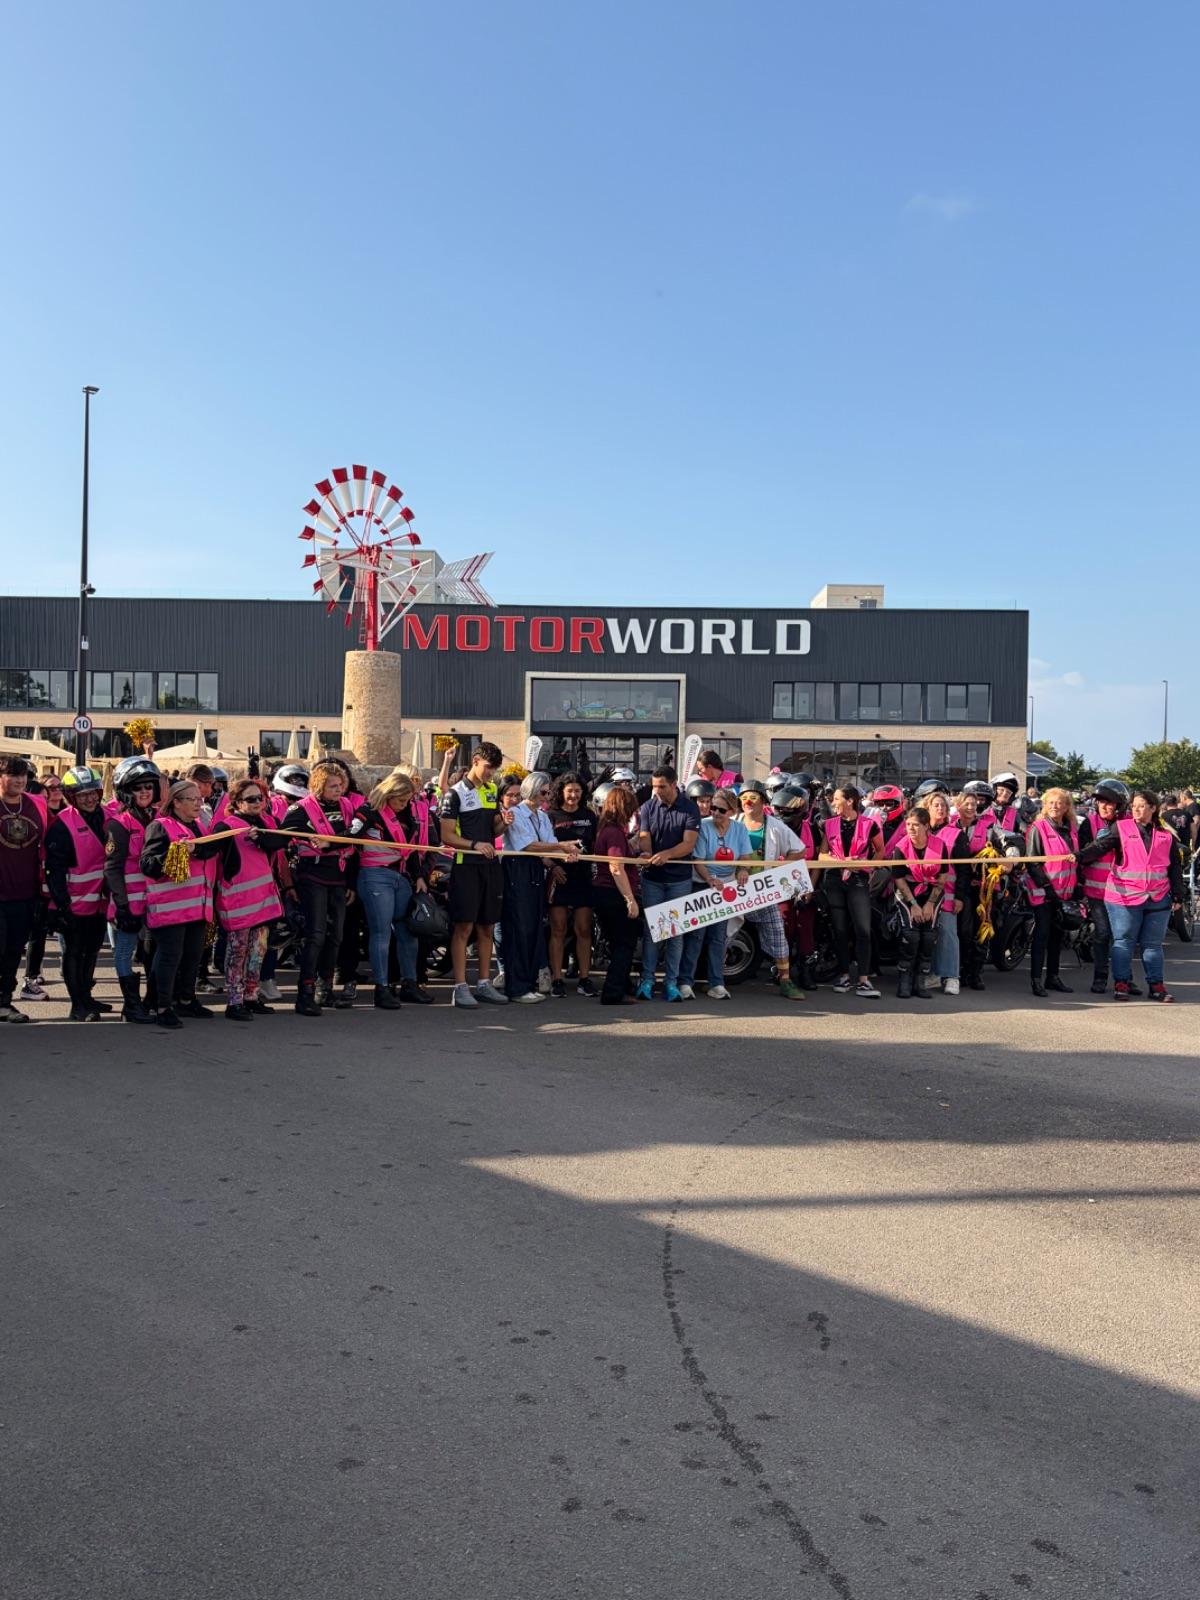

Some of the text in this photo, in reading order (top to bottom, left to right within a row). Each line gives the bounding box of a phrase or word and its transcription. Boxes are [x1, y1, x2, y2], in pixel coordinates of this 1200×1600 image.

[402, 614, 811, 655] MOTORWORLD
[76, 719, 89, 729] 10
[684, 875, 775, 915] AMIGOS DE
